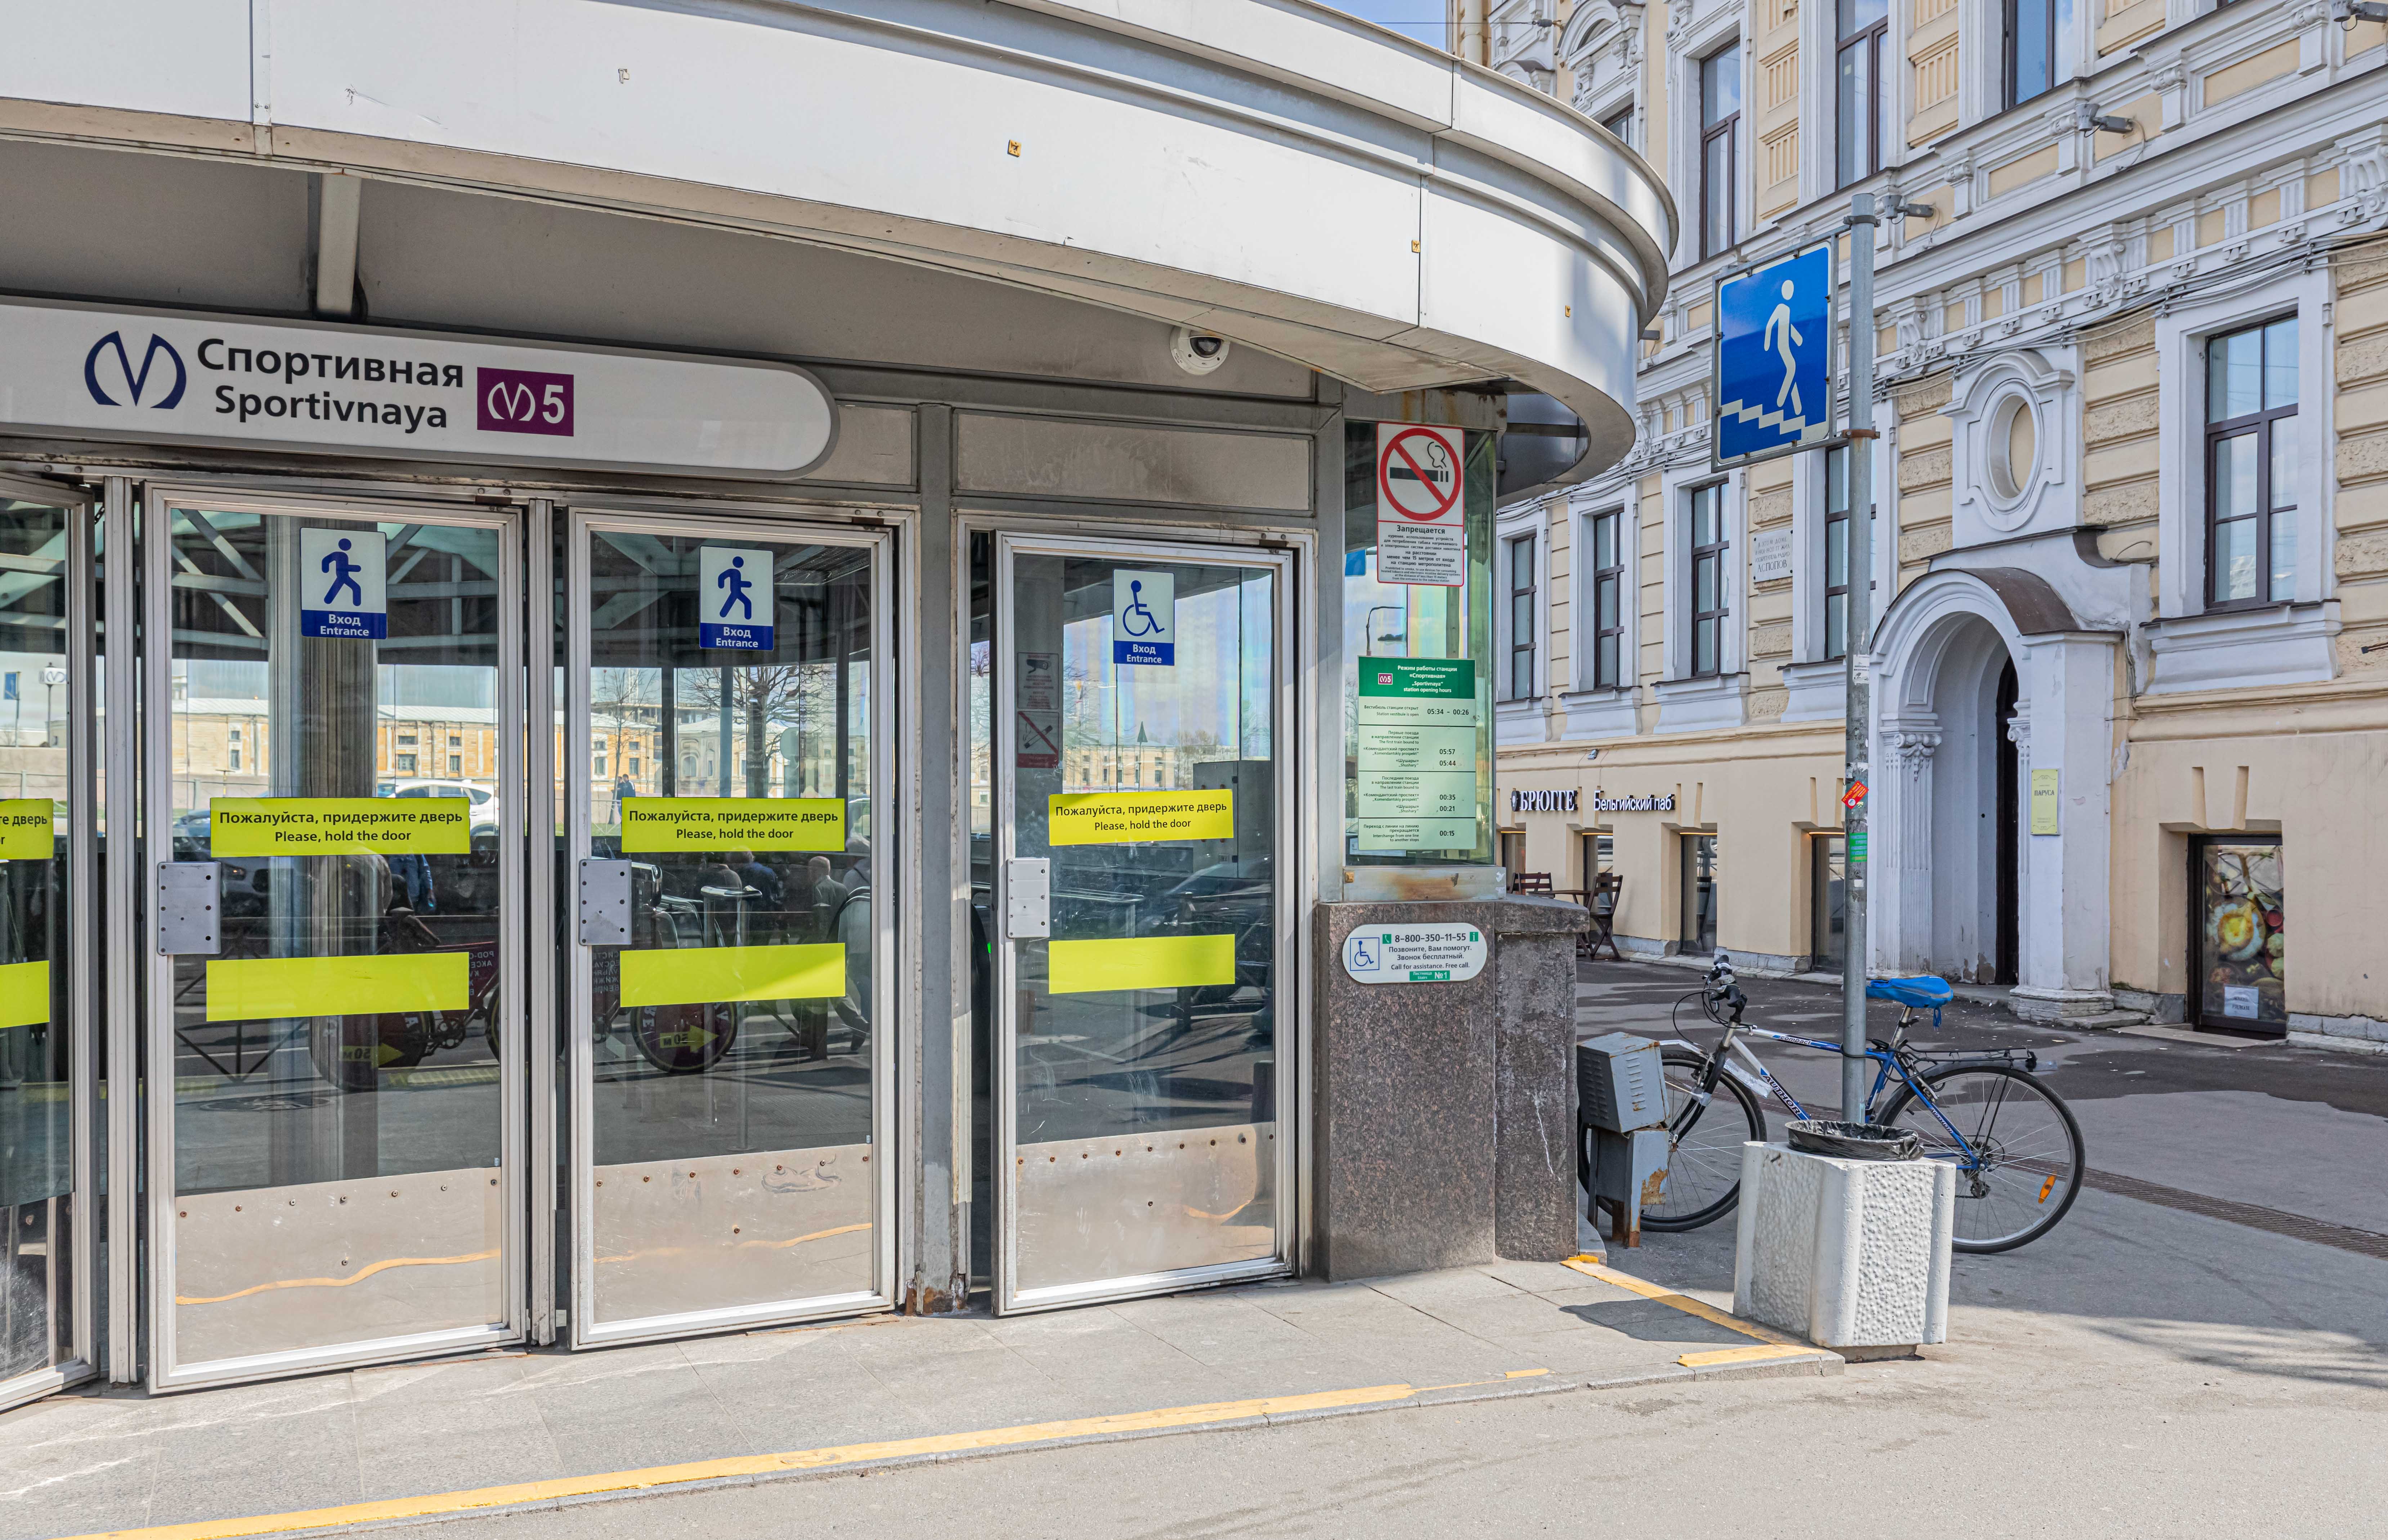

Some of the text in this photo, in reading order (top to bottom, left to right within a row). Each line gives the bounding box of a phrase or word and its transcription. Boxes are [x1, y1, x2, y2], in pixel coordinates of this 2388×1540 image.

[197, 338, 465, 388] Спортивная
[215, 385, 448, 434] Sportivnaya
[1397, 525, 1445, 534] Запрещается
[328, 614, 361, 626] Вход
[320, 626, 369, 636] Entrance
[723, 627, 751, 639] Вход
[716, 638, 758, 648] Entrance
[1133, 644, 1156, 654] Вход
[1126, 655, 1161, 663] Entrance
[1520, 790, 1673, 811] БРЮГГЕ Бельгийский паб
[1056, 803, 1227, 817] Пожалуйста, придержите дверь
[12, 815, 47, 827] дверь
[220, 811, 462, 826] Пожалуйста, придержите дверь
[630, 810, 838, 824] Пожалуйста, придержите дверь
[1095, 819, 1191, 831] Please, hold the door
[275, 831, 411, 842] Please, hold the door
[677, 829, 793, 840] Please, hold the door
[1780, 1036, 1811, 1044] compact
[1762, 1076, 1801, 1114] AUTHOR
[1929, 1108, 1953, 1133] AUTHOR
